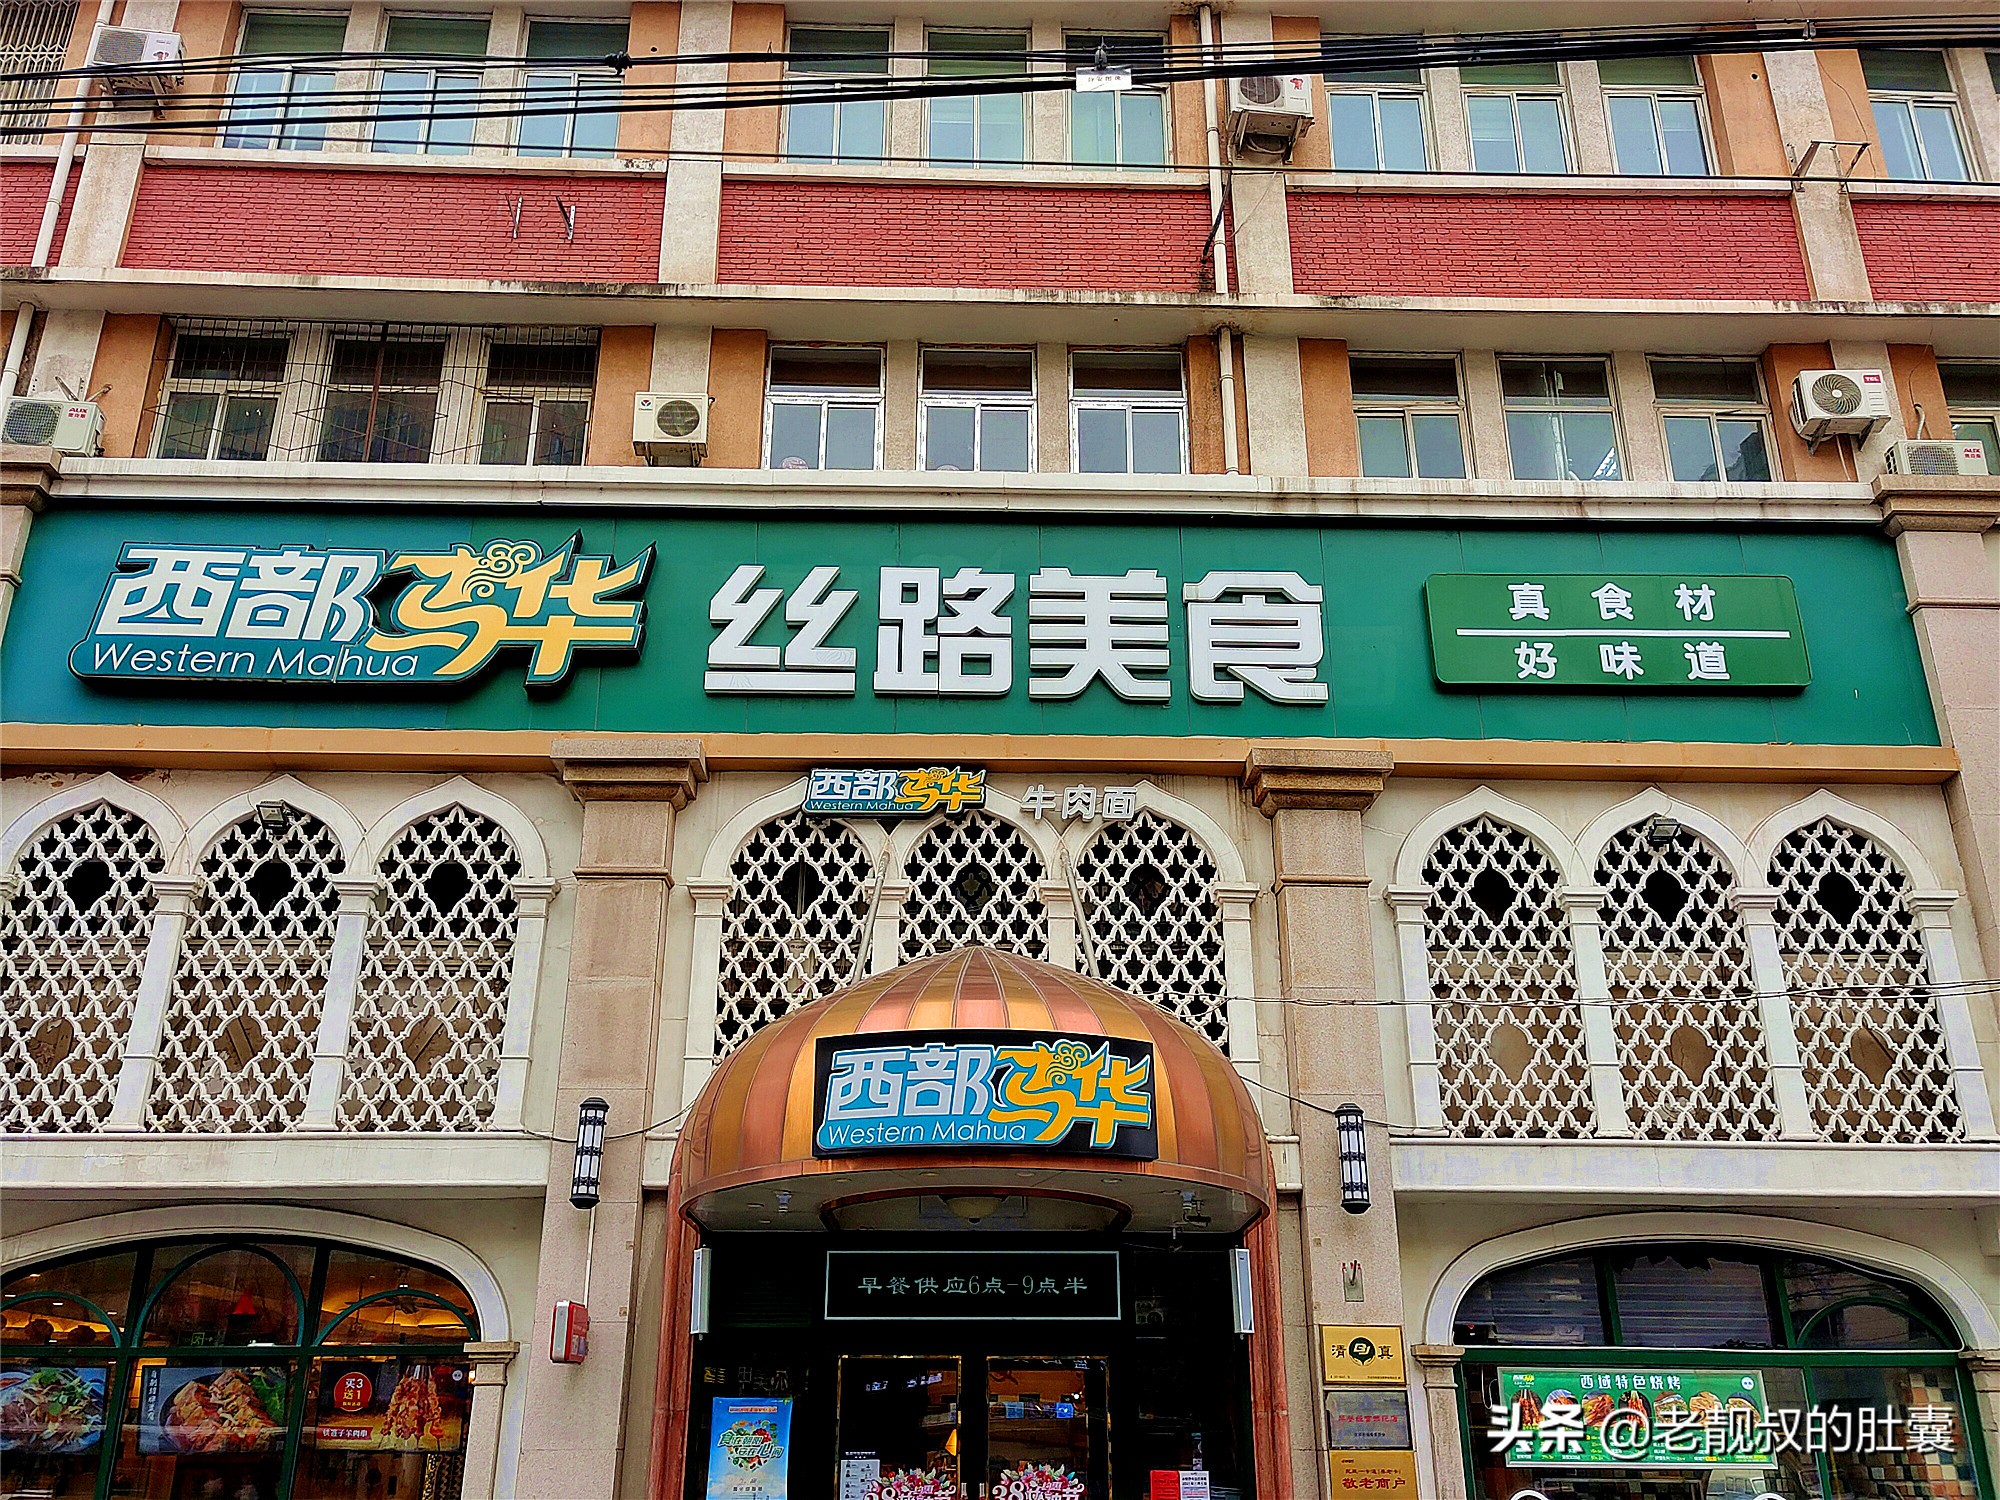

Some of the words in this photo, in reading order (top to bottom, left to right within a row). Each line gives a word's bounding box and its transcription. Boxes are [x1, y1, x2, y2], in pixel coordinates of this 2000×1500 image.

[1506, 582, 1716, 621] 真食材
[704, 563, 1329, 705] 丝路美食
[93, 642, 255, 673] Western
[266, 647, 419, 676] Mahua
[1514, 641, 1731, 680] 好味道
[809, 799, 870, 811] Western
[871, 800, 914, 812] Mahua
[1019, 783, 1137, 821] 牛肉面
[827, 1123, 925, 1145] Western
[931, 1121, 1027, 1142] Mahua
[857, 1275, 1088, 1295] 早餐供应6点-9点半
[345, 1378, 364, 1389] 买3
[1580, 1374, 1681, 1390] 西域特色烧烤
[343, 1389, 361, 1400] 送1
[1342, 1478, 1406, 1489] 敬老商户
